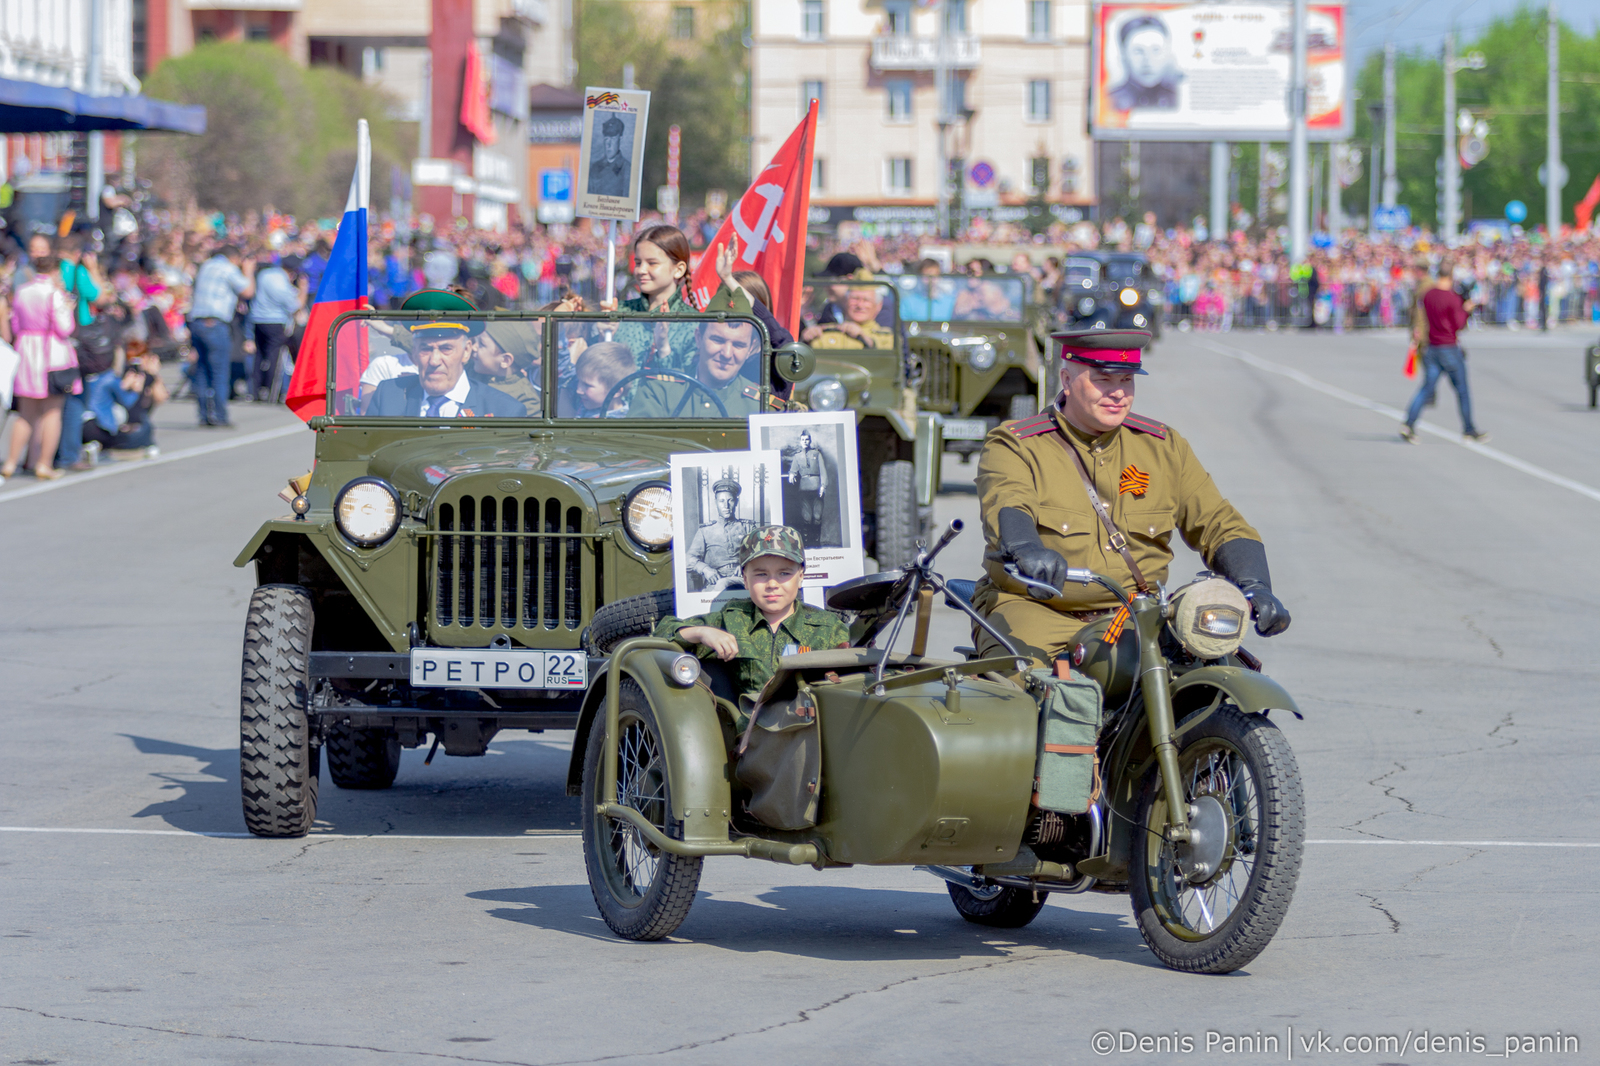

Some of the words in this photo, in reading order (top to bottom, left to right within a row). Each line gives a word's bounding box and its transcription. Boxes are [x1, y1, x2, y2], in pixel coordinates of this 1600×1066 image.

[422, 660, 535, 682] РЕТРО
[548, 655, 575, 675] 22
[547, 676, 567, 684] RUS
